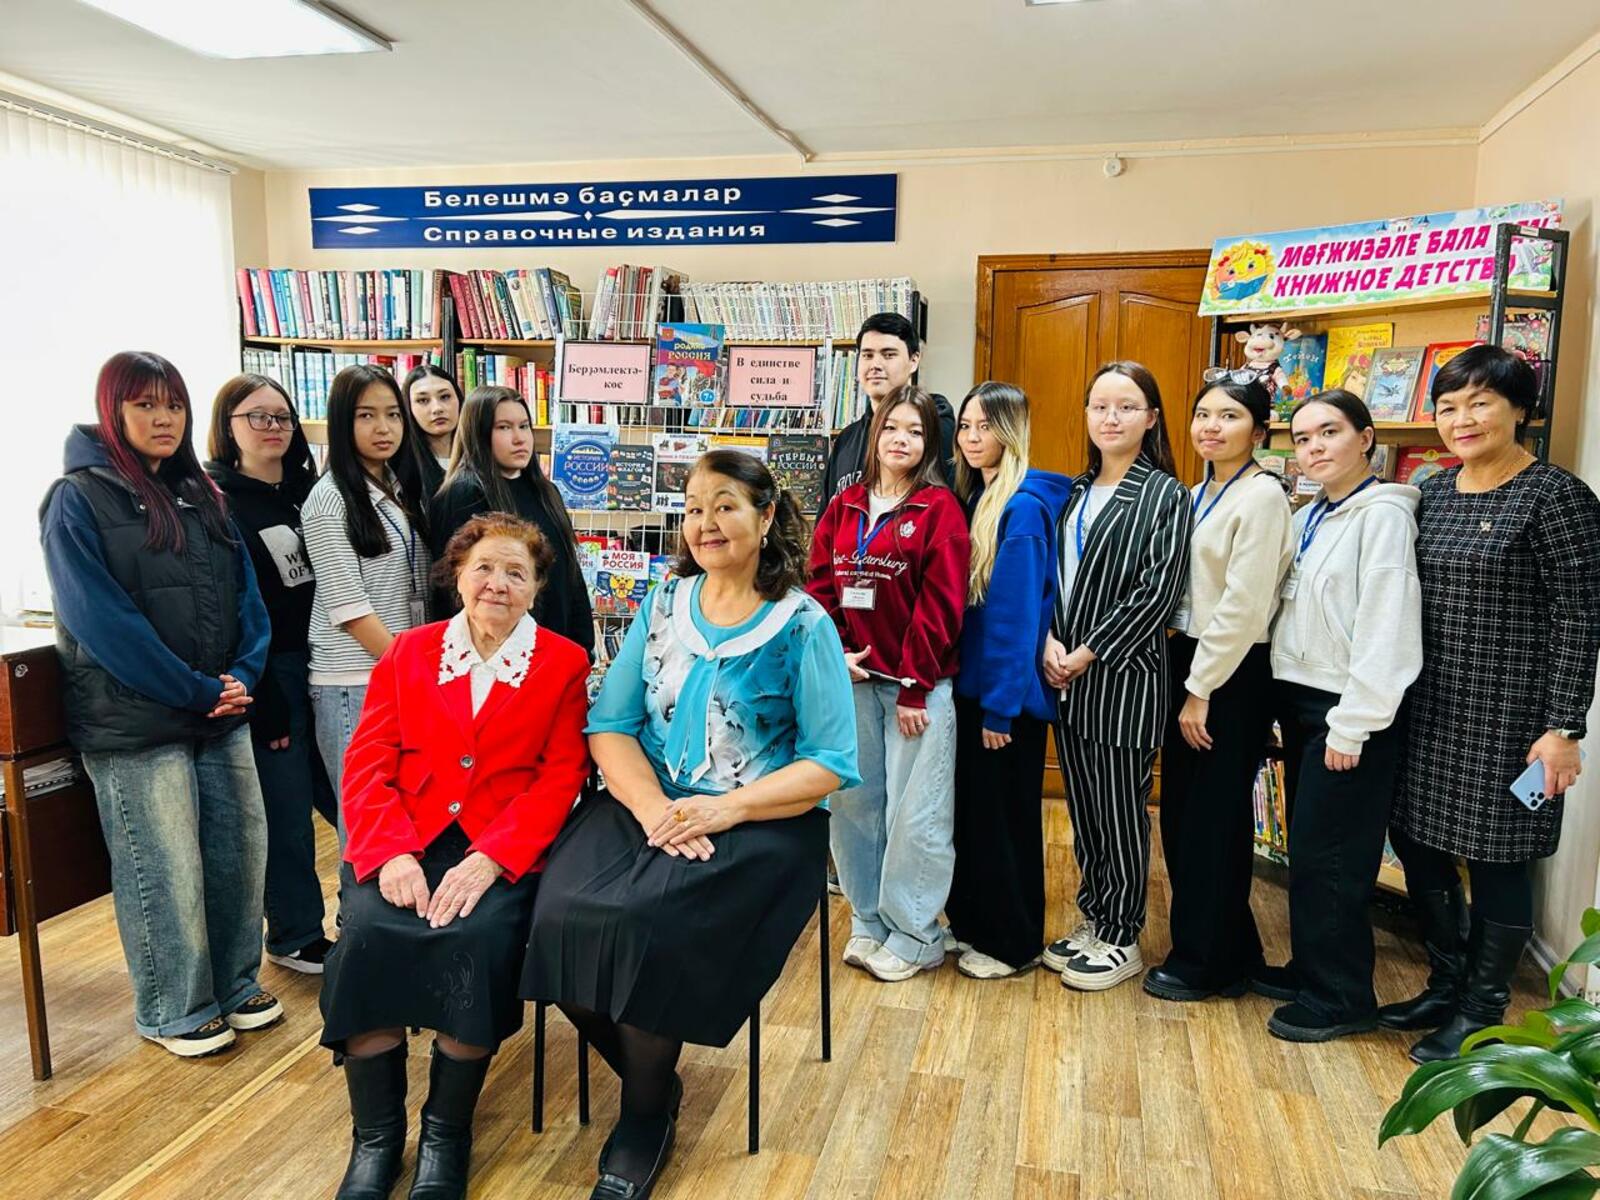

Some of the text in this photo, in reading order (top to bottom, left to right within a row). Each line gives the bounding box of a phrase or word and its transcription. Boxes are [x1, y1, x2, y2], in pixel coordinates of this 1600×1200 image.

[423, 185, 742, 208] Белешмә баҫмалар
[423, 221, 766, 245] Справочные издания
[1426, 224, 1491, 255] БАЛА
[1273, 265, 1393, 298] КНИЖНОЕ
[668, 351, 711, 360] РОССИЯ
[736, 357, 801, 368] В единстве
[750, 376, 790, 385] сила и
[750, 391, 788, 403] судьба
[778, 452, 816, 464] ГЕРБЫ
[564, 461, 609, 472] РОССИИ
[777, 461, 818, 470] РОССИИ
[611, 552, 636, 561] МОЯ
[602, 560, 644, 570] РОССИЯ
